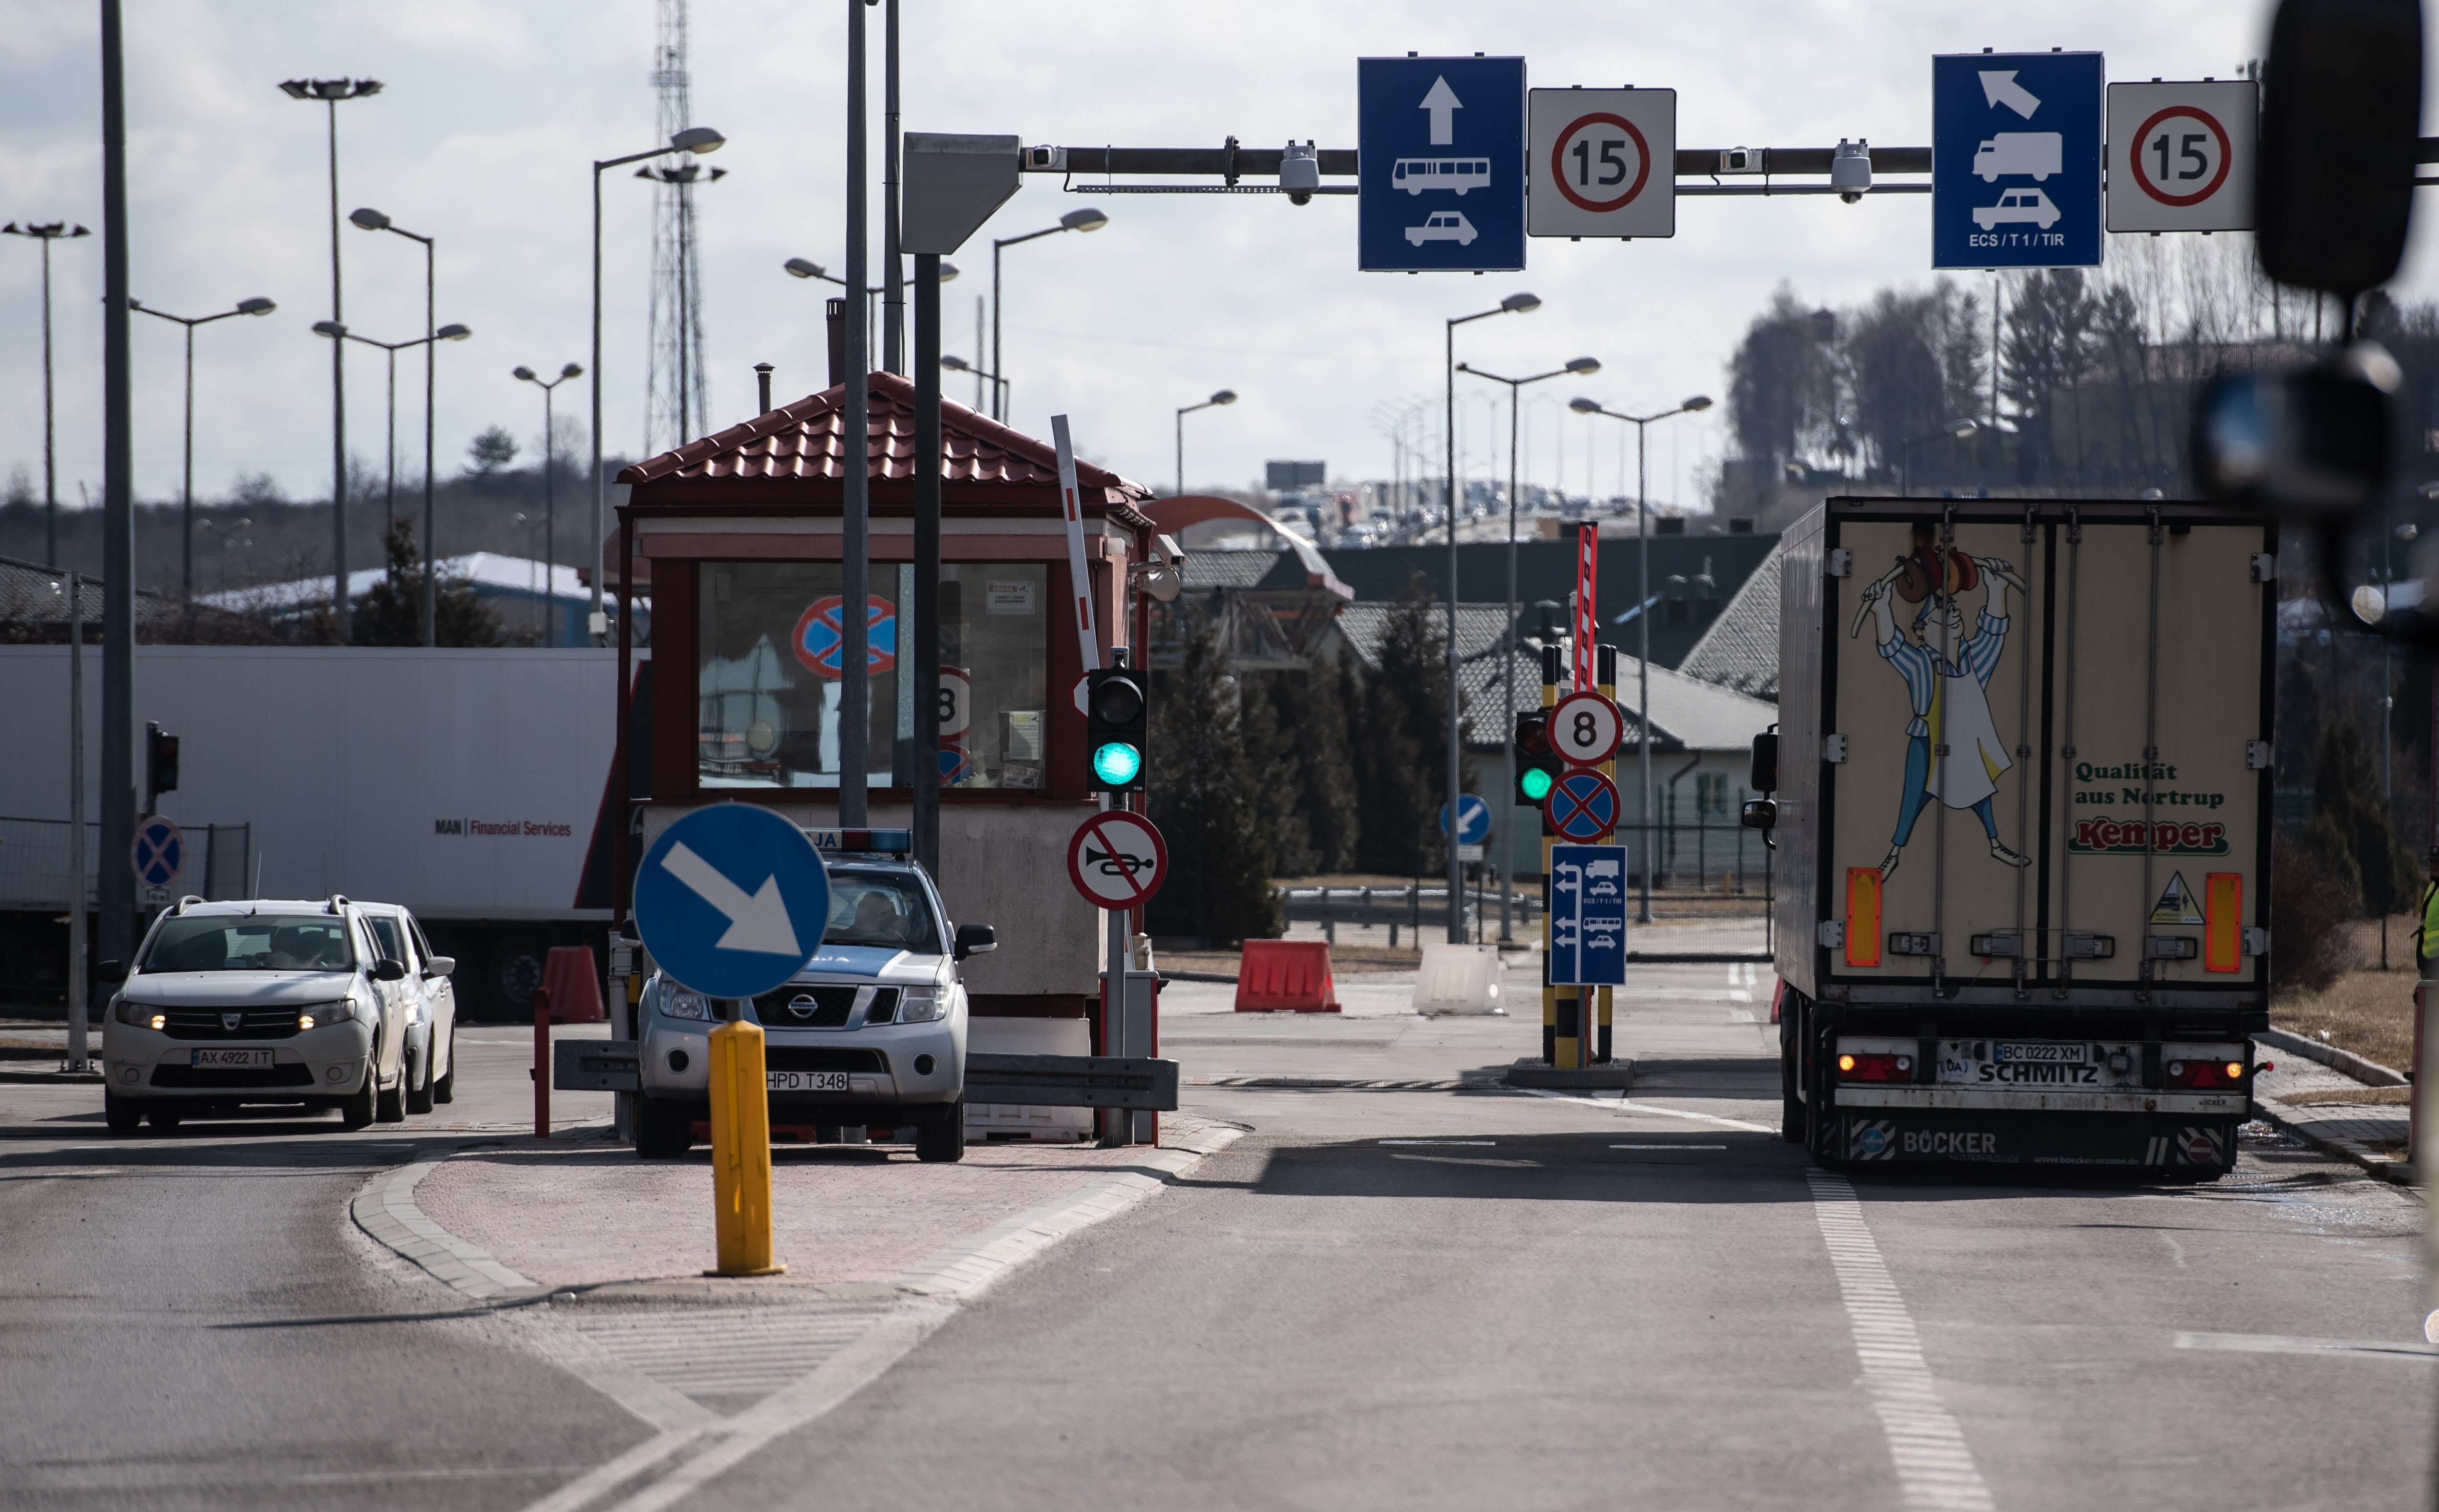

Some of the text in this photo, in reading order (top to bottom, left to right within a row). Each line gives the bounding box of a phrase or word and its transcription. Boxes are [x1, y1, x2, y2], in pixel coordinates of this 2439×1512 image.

[1572, 140, 1627, 186] 15
[2153, 134, 2207, 181] 15
[1970, 234, 1998, 246] ECS
[2010, 234, 2018, 246] T
[2022, 234, 2029, 246] 1
[2041, 233, 2064, 246] TIR
[939, 688, 955, 722] 8
[1573, 711, 1597, 747] 8
[2076, 762, 2177, 782] Qualität
[2075, 788, 2225, 809] aus Nortrup
[435, 819, 572, 836] MAN Financial Services
[2078, 819, 2222, 851] Kemper
[201, 1051, 218, 1064] AX
[221, 1051, 249, 1064] 4922
[2003, 1046, 2080, 1060] BC 0222 XM
[1947, 1061, 1963, 1071] UA
[1978, 1064, 2098, 1083] SCHMITZ
[766, 1073, 845, 1089] HPD T348
[1904, 1129, 1996, 1154] BÖCKER
